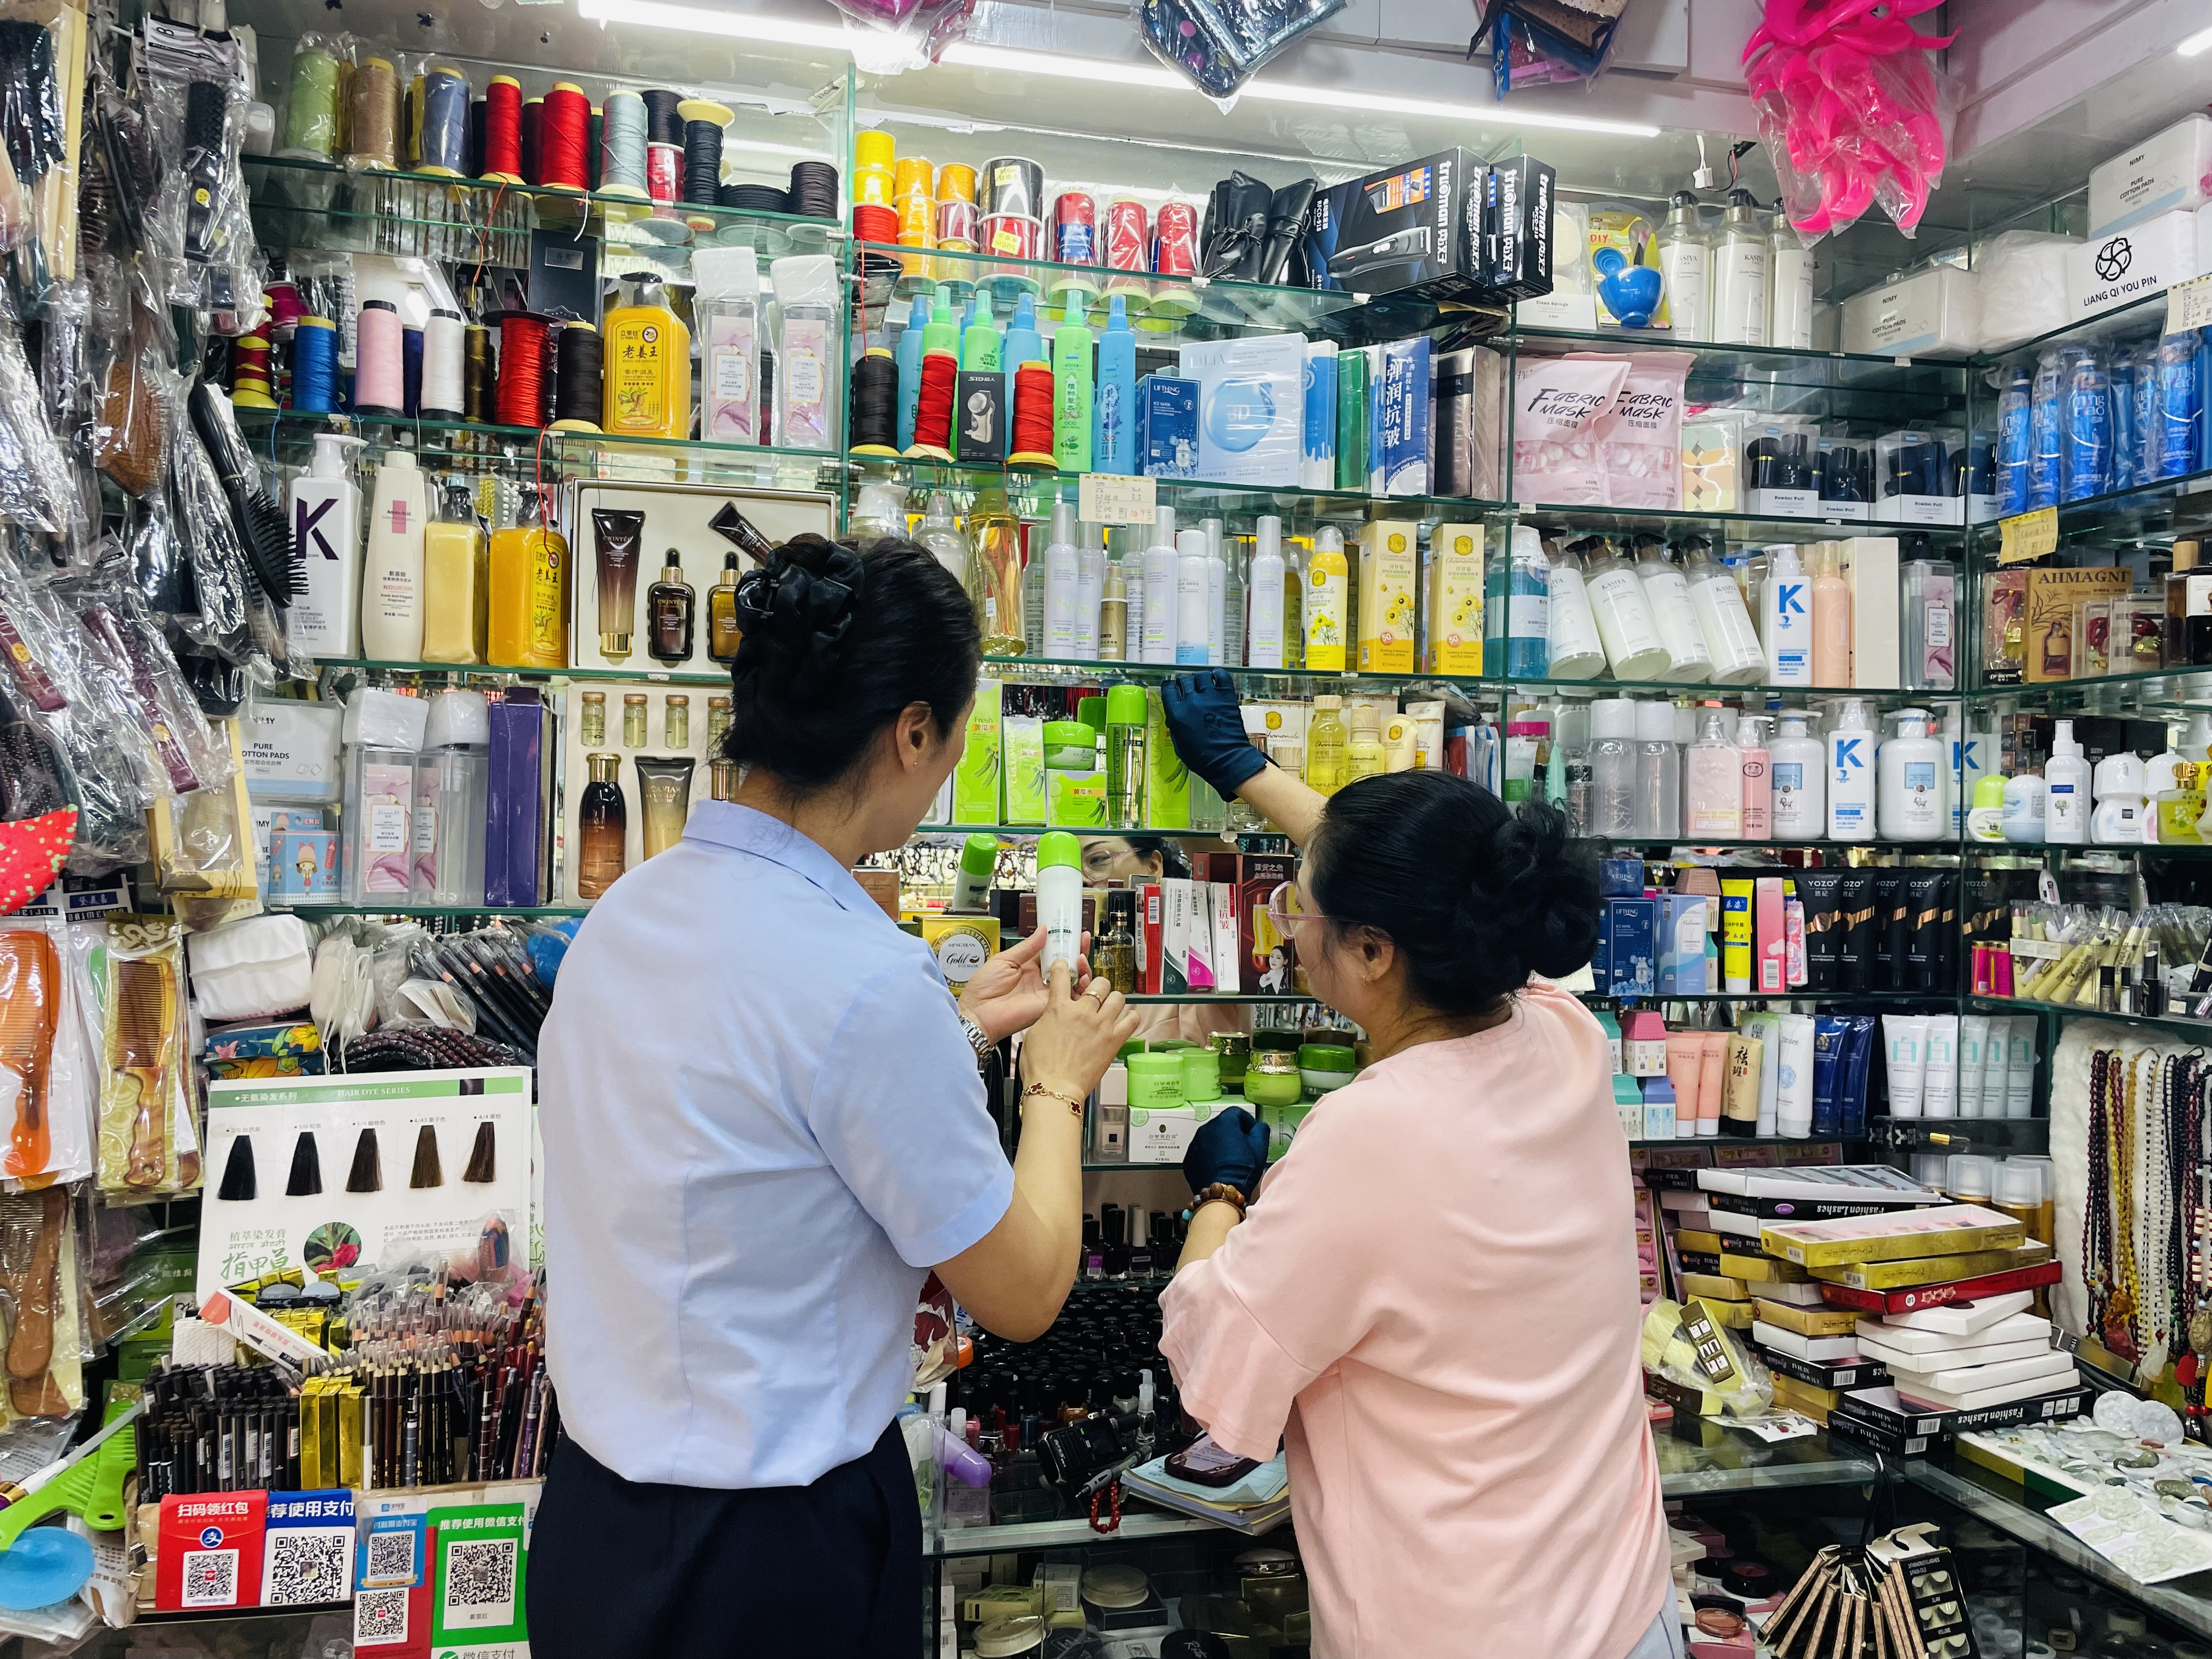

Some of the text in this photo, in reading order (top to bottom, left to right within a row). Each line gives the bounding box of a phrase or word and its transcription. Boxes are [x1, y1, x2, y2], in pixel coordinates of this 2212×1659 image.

[2130, 154, 2145, 166] NIMY
[2120, 178, 2154, 200] COTTON PADS
[2131, 176, 2144, 187] PURE
[1437, 160, 1452, 227] trueman
[1503, 169, 1516, 235] trueman
[1590, 234, 1609, 244] DIY
[2083, 275, 2158, 307] LIANG QI YOU PIN
[1882, 295, 1898, 304] NIMY
[1893, 319, 1906, 328] PADS
[622, 344, 658, 359] 老姜王
[1385, 361, 1403, 449] 弹润抗皱
[1547, 417, 1579, 430] 压缩面膜
[1628, 420, 1657, 430] 压缩面膜
[1386, 469, 1401, 487] IMPROVE
[297, 497, 339, 560] K
[1601, 578, 1626, 591] KASIYA
[1778, 584, 1805, 613] K
[242, 750, 268, 759] OTTON
[1007, 731, 1017, 785] CUCUMBER
[1836, 739, 1864, 768] K
[1953, 741, 1980, 770] K
[1219, 909, 1229, 930] 抗皱
[933, 928, 990, 957] GOLDEN LADY'S EYE MASK
[946, 952, 967, 966] Gold
[240, 1091, 297, 1102] 无氨染发系列
[381, 1087, 410, 1095] SERIES
[1816, 1204, 1885, 1215] Fashion Lashes
[230, 1228, 286, 1241] 植萃染发膏
[1957, 1407, 2024, 1425] Fashion Lashes
[177, 1502, 249, 1517] 扫码领红包
[267, 1500, 356, 1519] 荐使用支付
